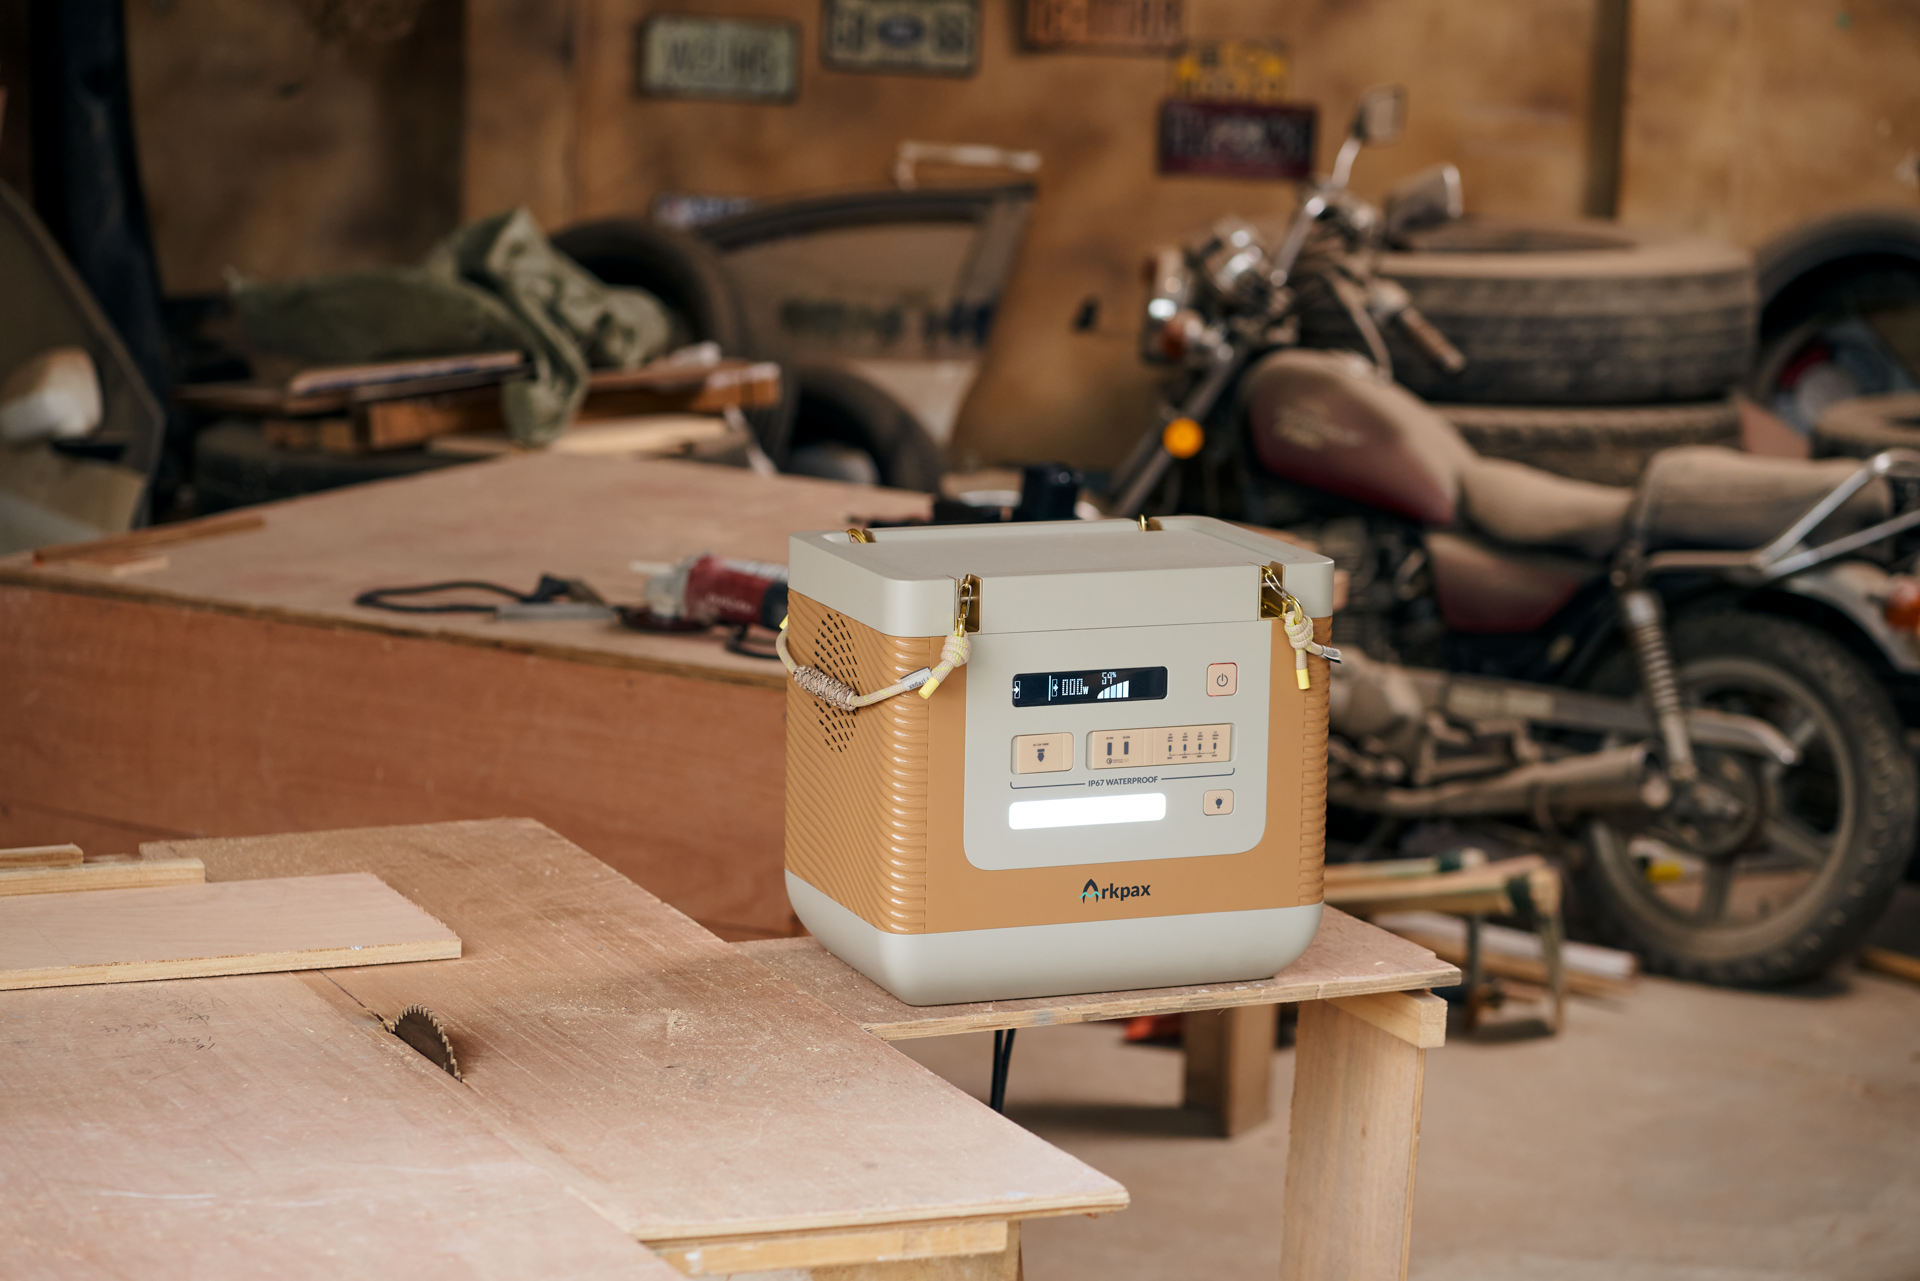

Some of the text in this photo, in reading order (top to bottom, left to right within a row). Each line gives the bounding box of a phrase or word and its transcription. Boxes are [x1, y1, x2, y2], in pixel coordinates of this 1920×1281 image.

[1088, 775, 1159, 787] IP67 WATERPROOF
[1079, 878, 1151, 904] Arkpax
